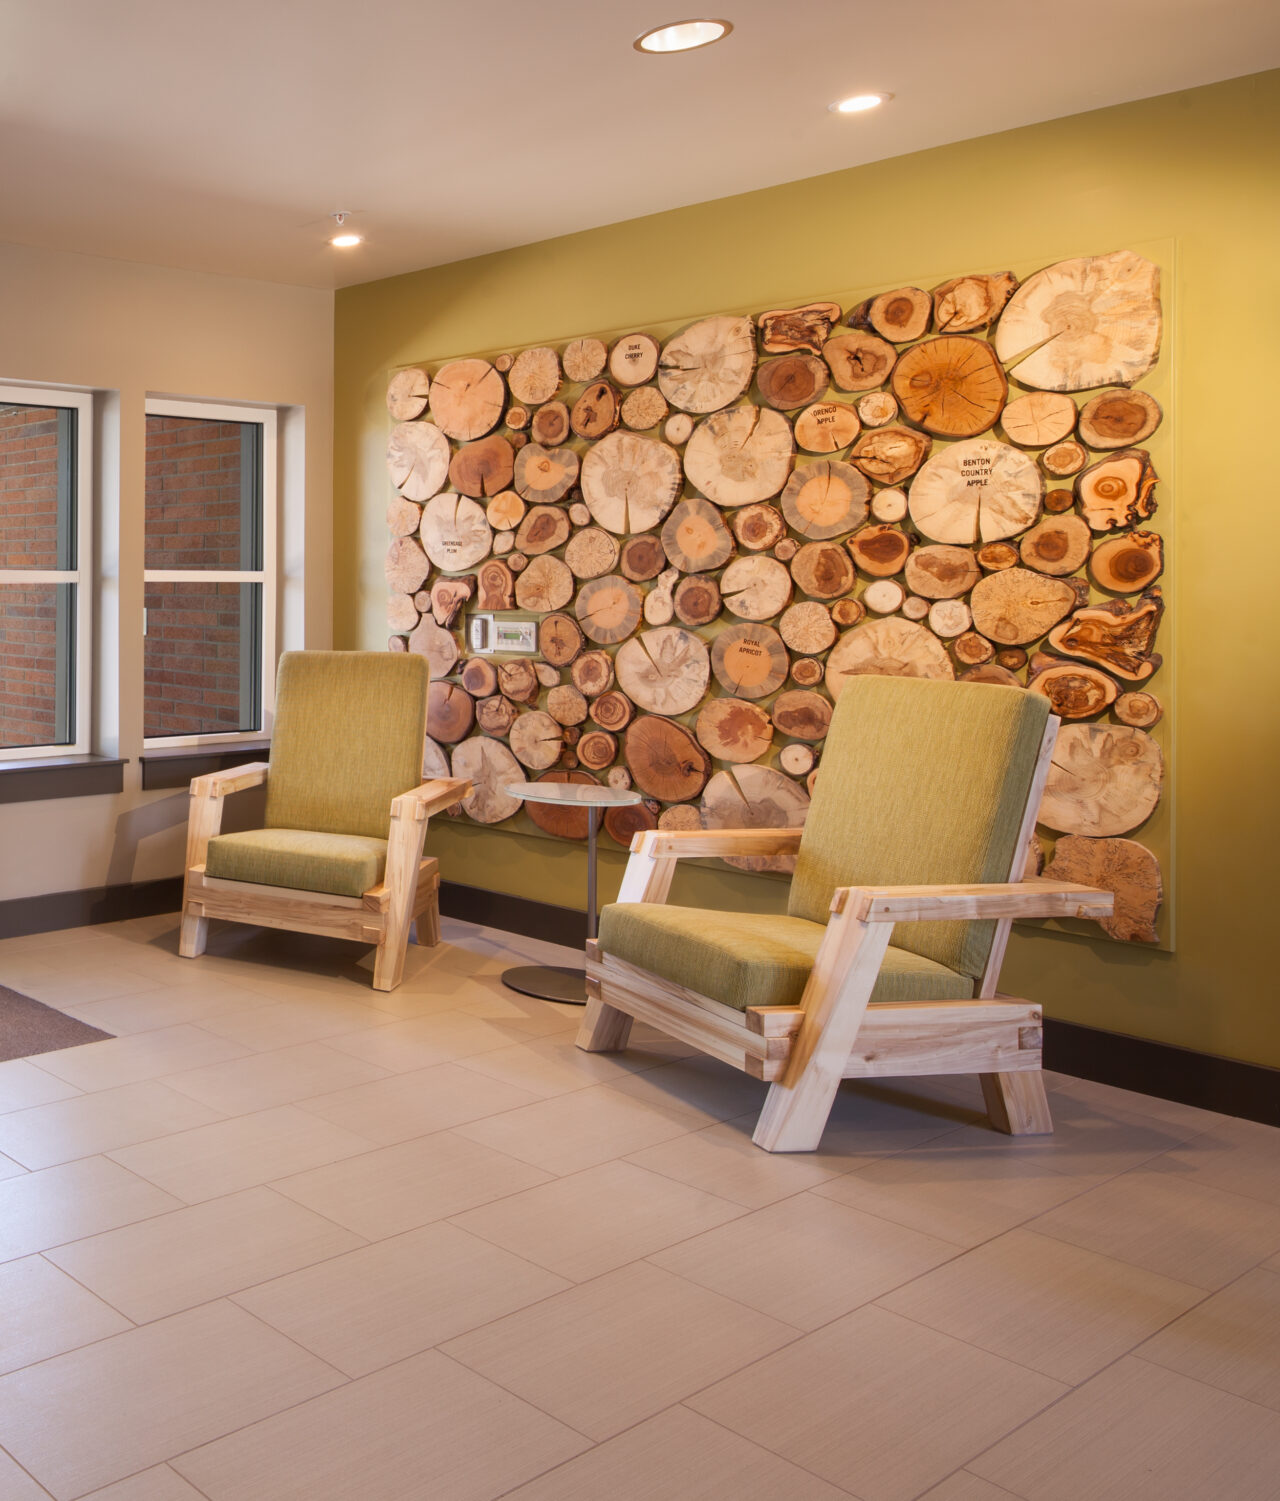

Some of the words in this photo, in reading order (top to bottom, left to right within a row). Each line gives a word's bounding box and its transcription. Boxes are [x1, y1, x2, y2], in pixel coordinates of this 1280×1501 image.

[813, 406, 837, 417] ORENCO
[816, 416, 836, 425] APPLE
[963, 458, 991, 467] BENTON
[960, 468, 993, 477] COUNTRY
[966, 478, 989, 488] APPLE
[743, 638, 760, 648] ROYAL
[738, 647, 763, 657] APRICOT
